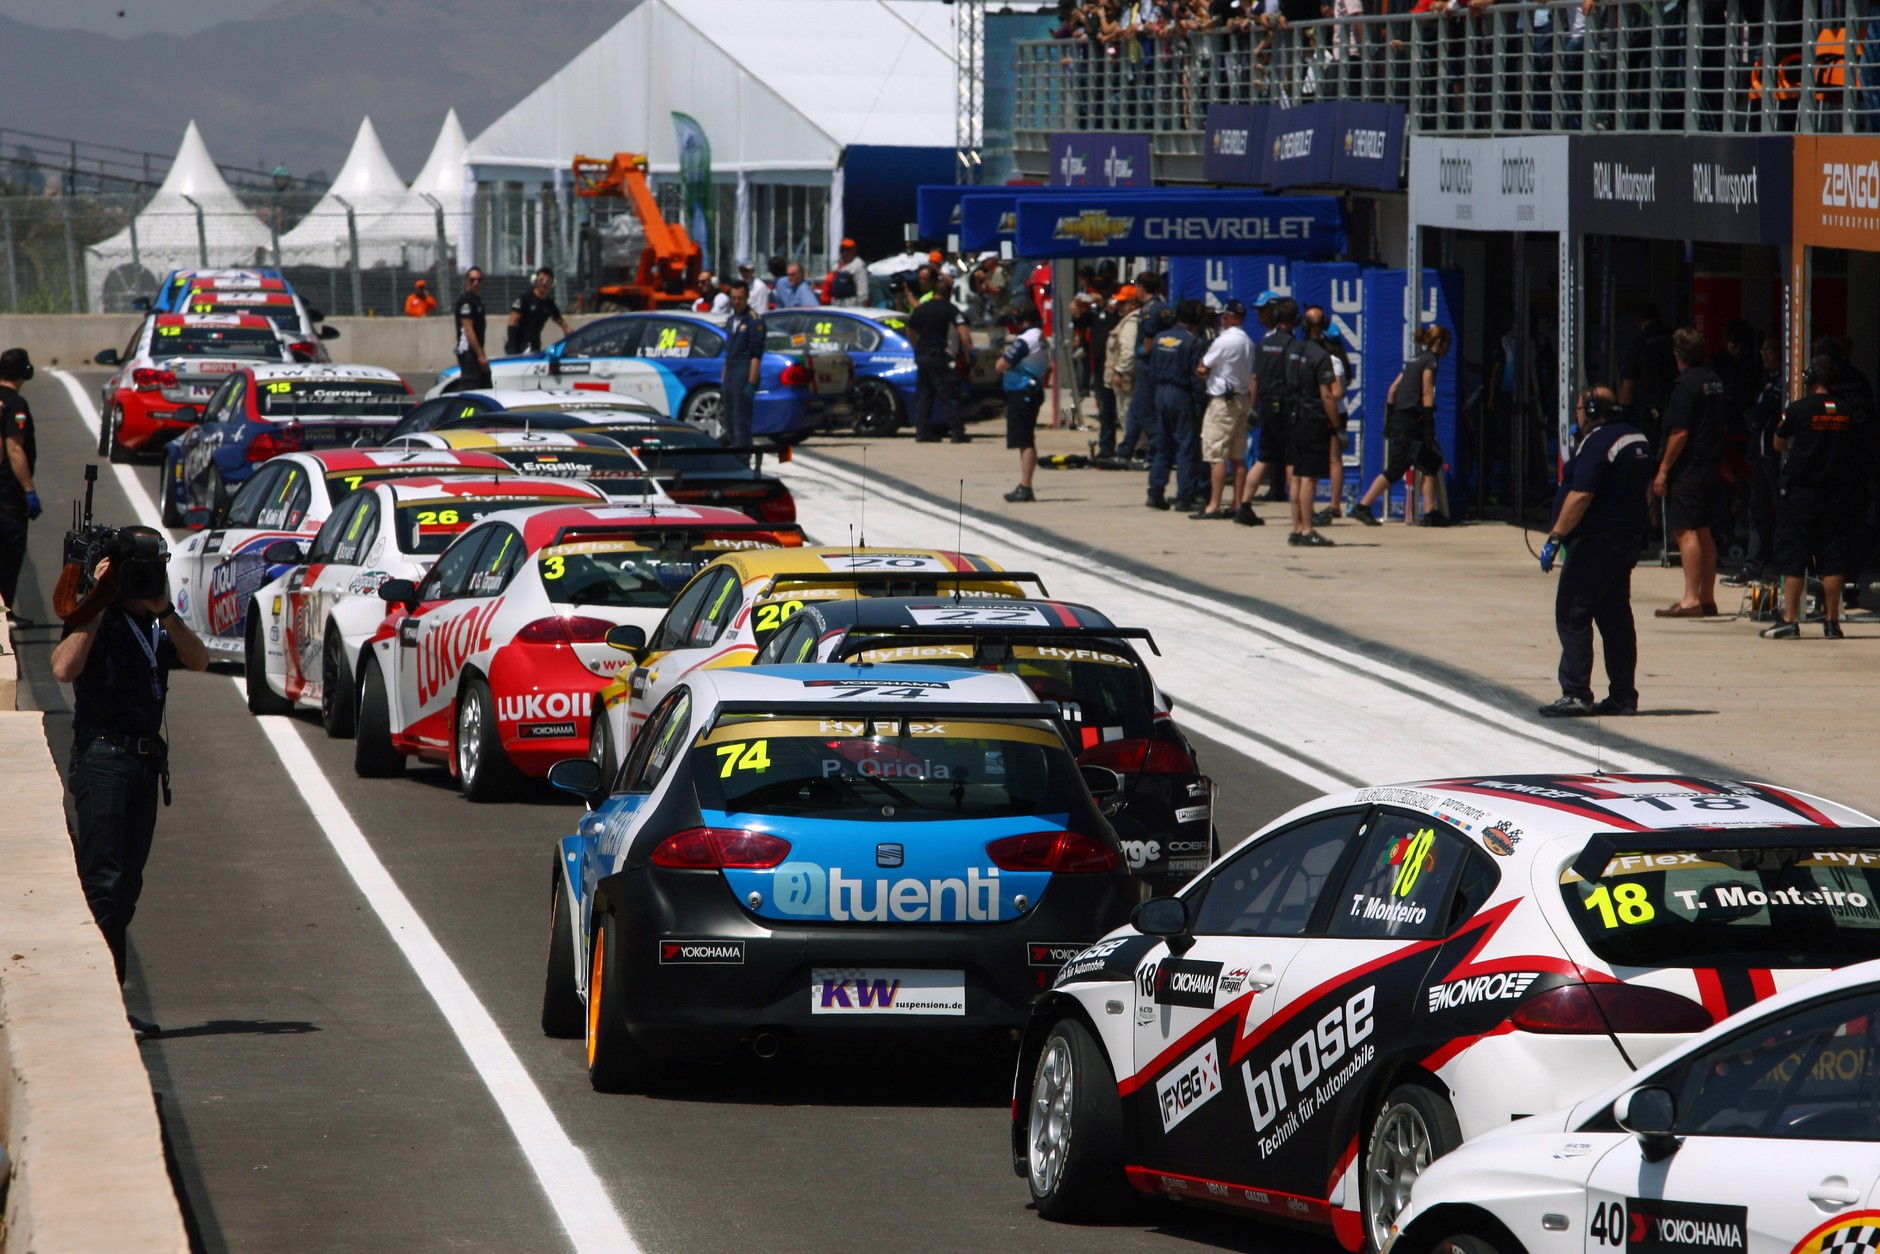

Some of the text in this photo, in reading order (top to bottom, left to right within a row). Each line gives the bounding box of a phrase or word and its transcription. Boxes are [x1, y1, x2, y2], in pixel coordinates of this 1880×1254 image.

[1220, 129, 1248, 156] CHEVROLET
[1280, 129, 1314, 160] CHEVROLET
[1353, 129, 1386, 159] CHEVROLET
[1593, 162, 1656, 210] ROAL Motorsport
[1693, 163, 1758, 213] ROAL Motorsport
[1144, 217, 1315, 240] CHEVROLET
[1822, 214, 1880, 230] MOTORSPORT
[158, 327, 182, 336] 12
[201, 363, 236, 372] MOTUL
[266, 382, 292, 395] 15
[511, 445, 574, 453] HyFlex
[523, 461, 593, 473] Engstler
[344, 476, 364, 490] 7
[464, 494, 540, 503] HyFlex
[416, 509, 460, 525] 26
[547, 542, 625, 555] HyFlex
[544, 556, 566, 580] 3
[843, 557, 927, 568] 20
[212, 561, 238, 598] LIQUI
[756, 588, 839, 603] HyFlex
[214, 592, 240, 631] MOLY
[755, 600, 805, 632] 20
[933, 609, 1032, 622] 22
[416, 595, 506, 709] LUKOIL
[863, 646, 954, 661] HyFlex
[1037, 645, 1131, 665] HyFlex
[829, 687, 930, 700] 74
[838, 680, 943, 688] YOKOHAMA
[498, 692, 594, 722] LUKOIL
[531, 725, 575, 736] YOKOHAMA
[818, 720, 947, 737] HyFlex
[715, 739, 950, 780] 74 P. Oriola
[1627, 796, 1751, 812] 18
[1390, 828, 1436, 898] 18
[1812, 852, 1880, 867] HyF
[829, 866, 1000, 922] tuenti
[1350, 894, 1428, 925] T. Monteiro
[1584, 882, 1869, 930] 18 T. Monteiro
[680, 946, 742, 960] YOKOHAMA
[1049, 948, 1080, 961] YOKO
[1136, 962, 1215, 998] 18 YOKOHAMA
[820, 978, 964, 1012] KW suspensions.de
[1437, 973, 1520, 1012] MONROE
[1241, 985, 1376, 1133] brose
[1257, 1044, 1375, 1160] Technik für Automobile
[1589, 1201, 1743, 1249] 40 YOKOHAMA
